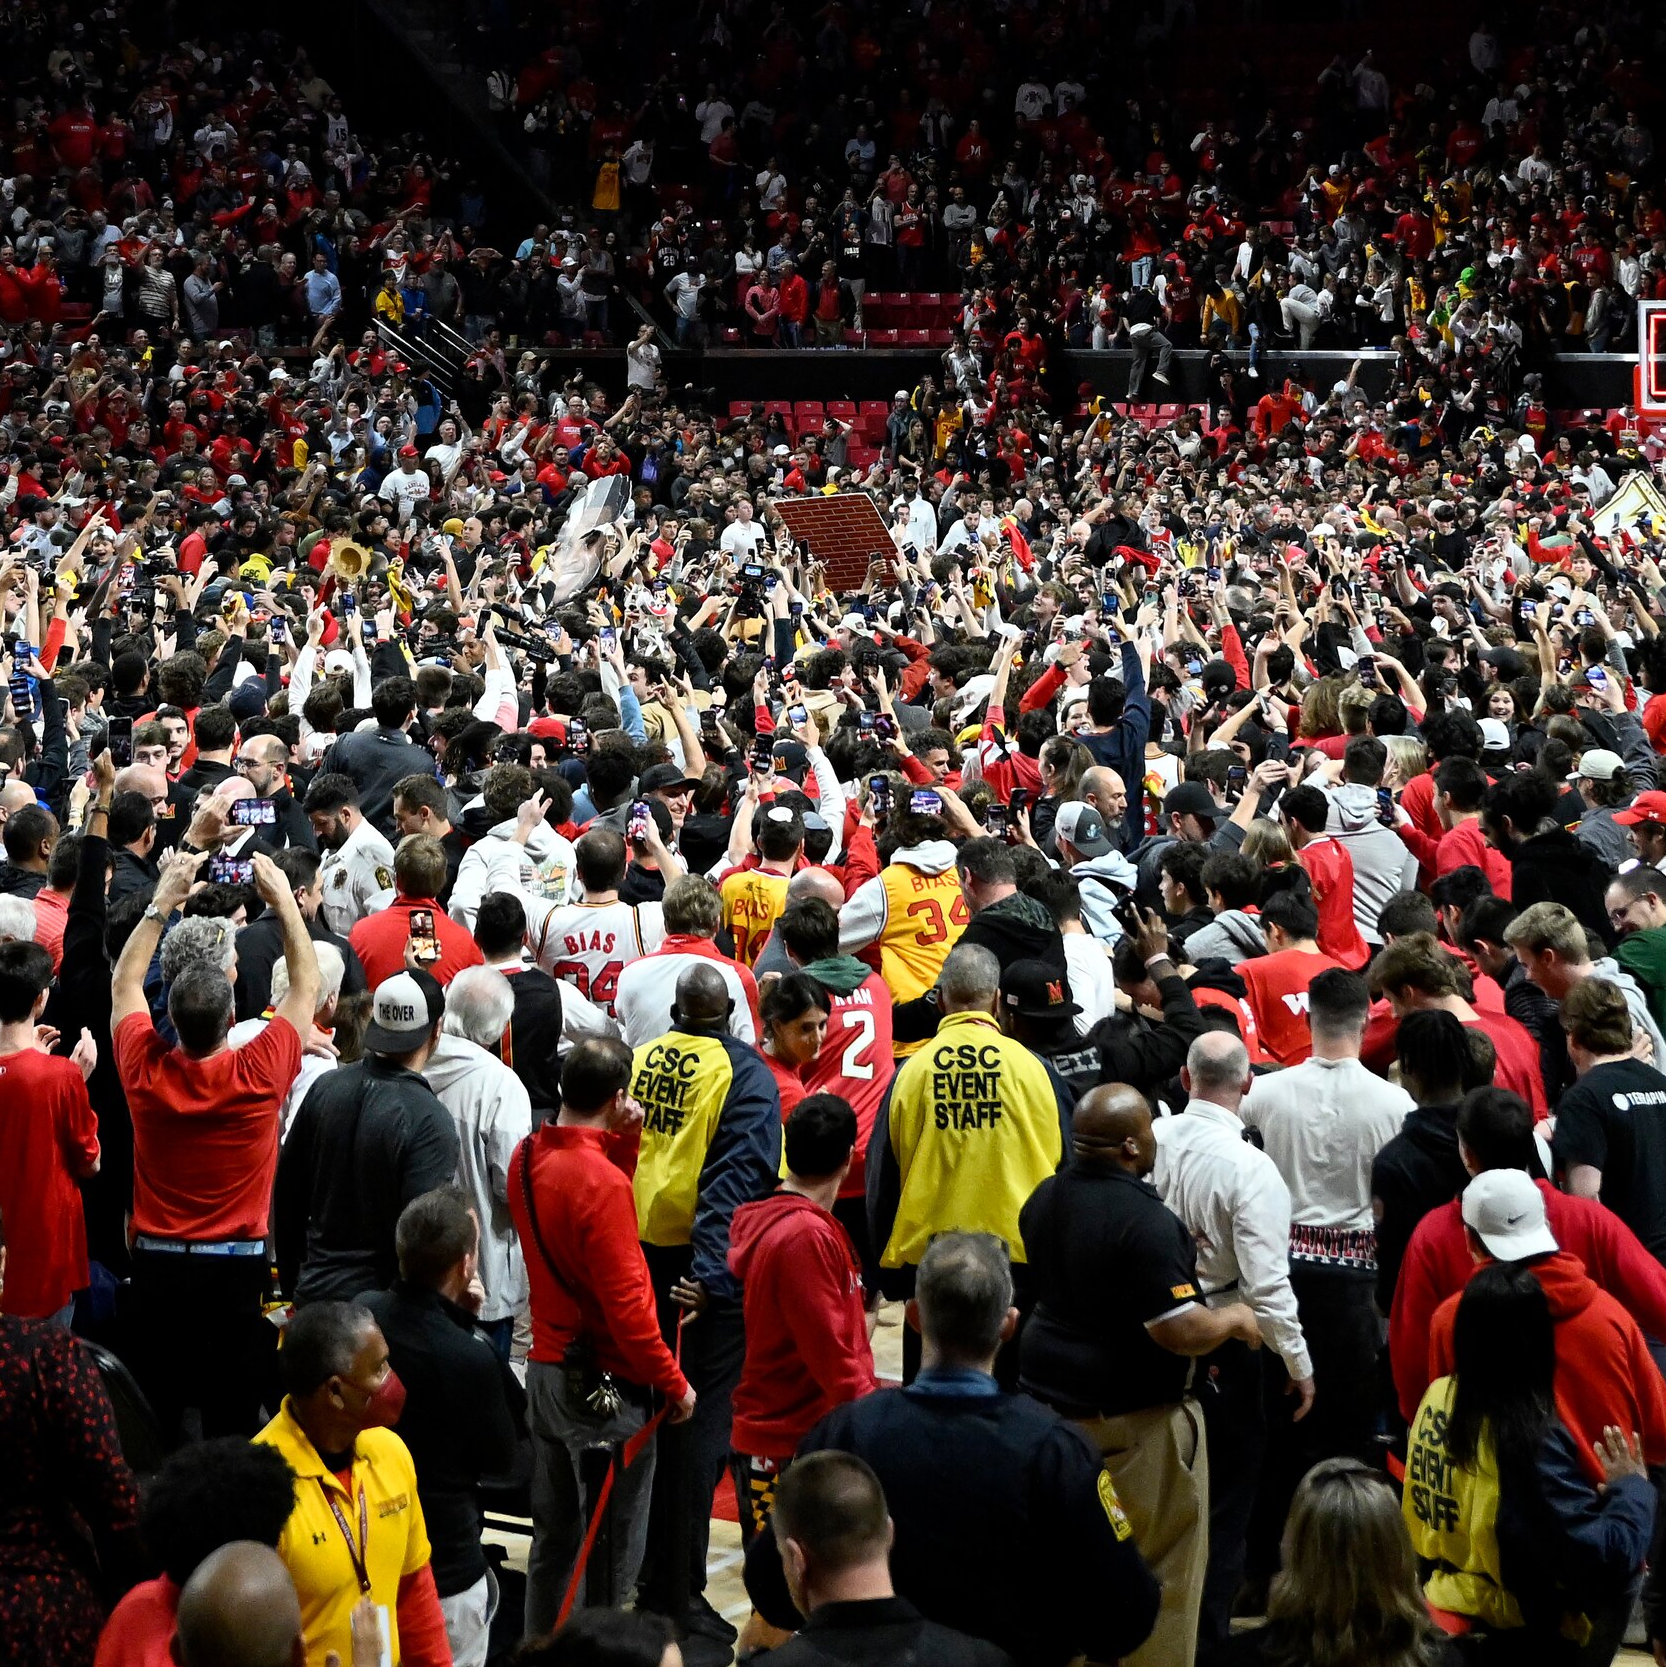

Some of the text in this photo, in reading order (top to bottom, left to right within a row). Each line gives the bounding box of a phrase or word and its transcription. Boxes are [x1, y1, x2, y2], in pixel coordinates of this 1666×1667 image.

[775, 756, 787, 770] M
[911, 874, 958, 893] BIAS
[734, 899, 769, 920] BIAS
[907, 894, 969, 946] 34
[564, 930, 616, 955] BIAS
[1046, 979, 1064, 1002] M
[379, 1003, 414, 1021] THE OVER
[842, 1010, 874, 1080] 2
[933, 1044, 1001, 1070] CSC
[645, 1044, 700, 1079] CSC
[634, 1069, 691, 1108] EVENT
[933, 1072, 1001, 1099] EVENT
[643, 1100, 684, 1136] TAFF
[935, 1101, 1002, 1130] STAFF
[1412, 1444, 1455, 1494] EVENT
[1412, 1485, 1459, 1533] STAFF
